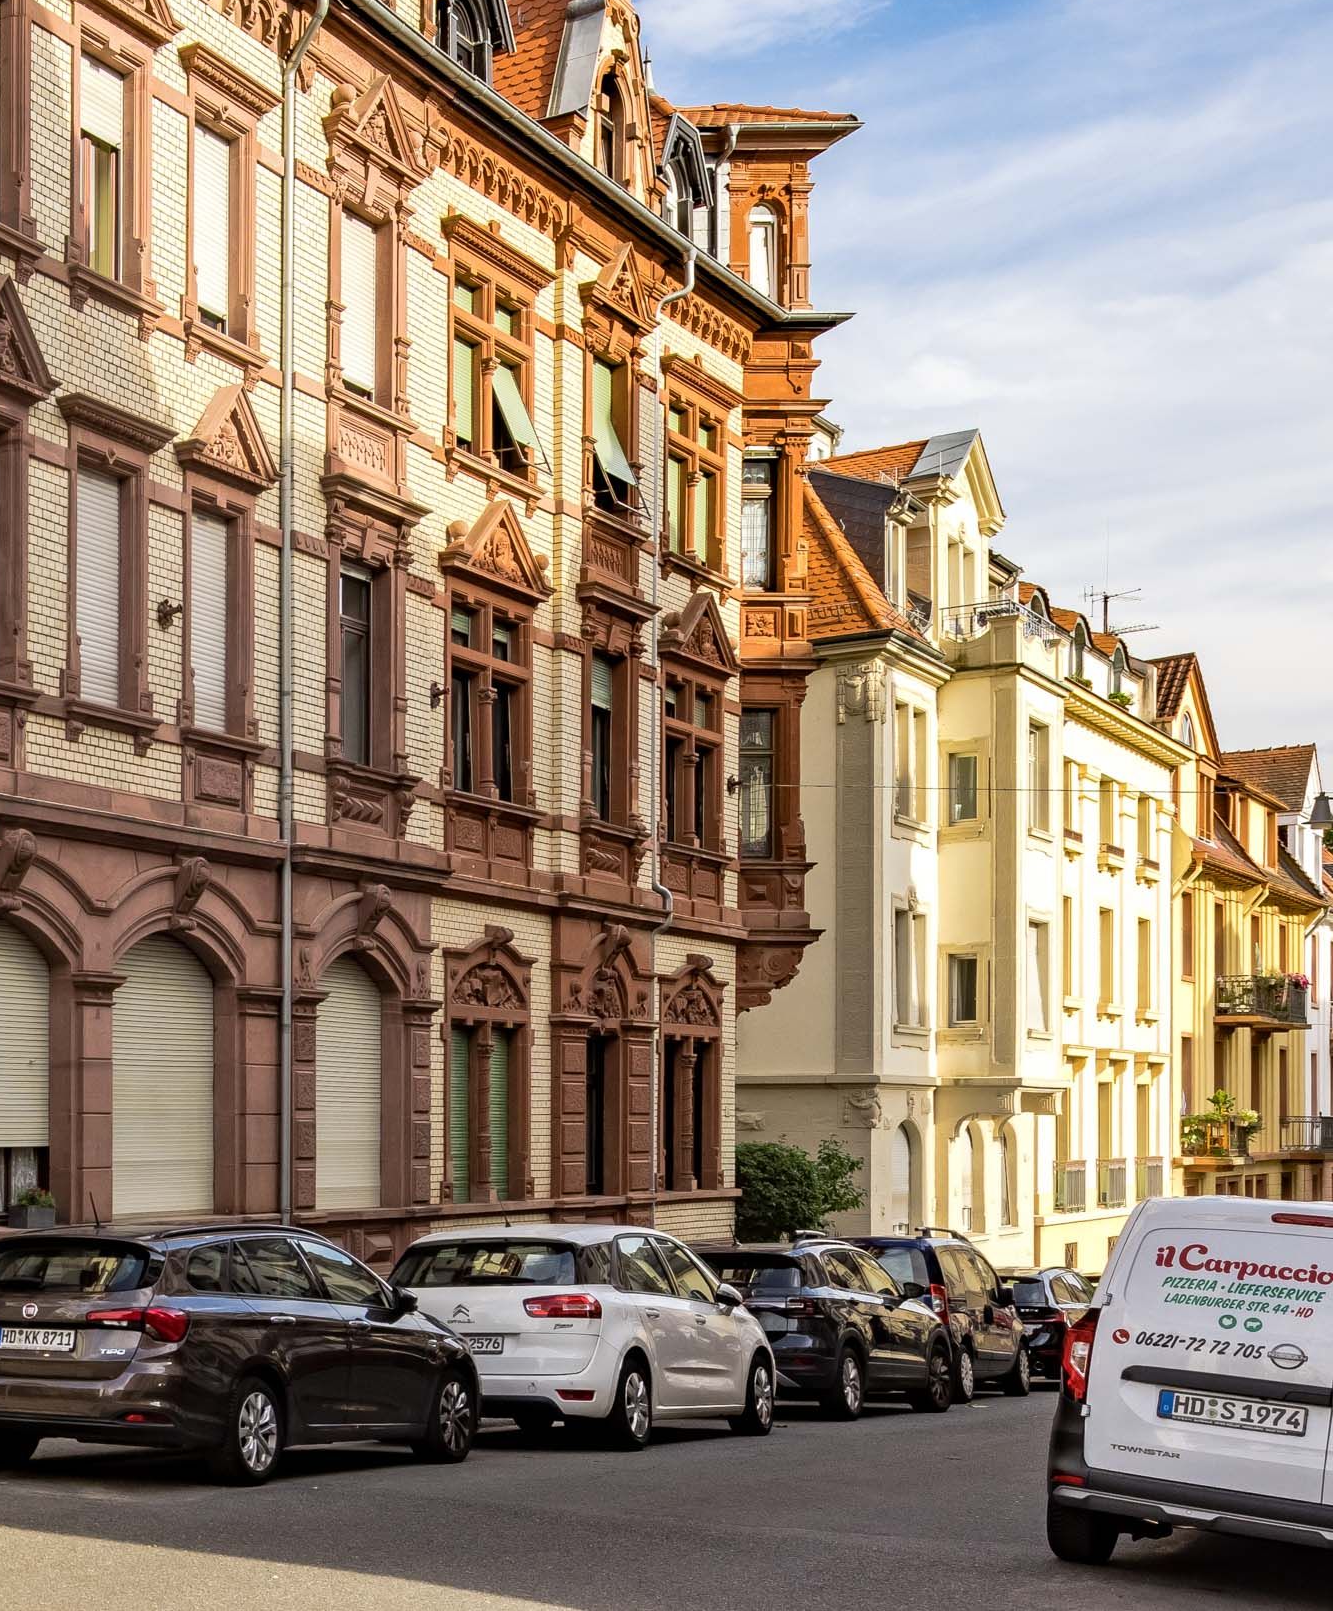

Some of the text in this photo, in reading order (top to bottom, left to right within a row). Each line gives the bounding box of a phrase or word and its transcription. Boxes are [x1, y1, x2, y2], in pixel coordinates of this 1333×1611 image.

[1155, 1243, 1333, 1285] il Carpaccio
[1162, 1276, 1326, 1303] PIZZERIA LIEFERSERVICE
[1164, 1292, 1314, 1319] LADENBURGER STR. 44 HD
[1, 1329, 71, 1346] HD KK 8711
[470, 1337, 500, 1350] 2576
[1135, 1331, 1207, 1352] 06221-72
[1209, 1339, 1231, 1355] 72
[1233, 1343, 1266, 1359] 705
[1174, 1394, 1206, 1417] HD
[1220, 1401, 1236, 1420] S
[1241, 1403, 1301, 1429] 1974
[1110, 1443, 1181, 1459] TOWNSTAR
